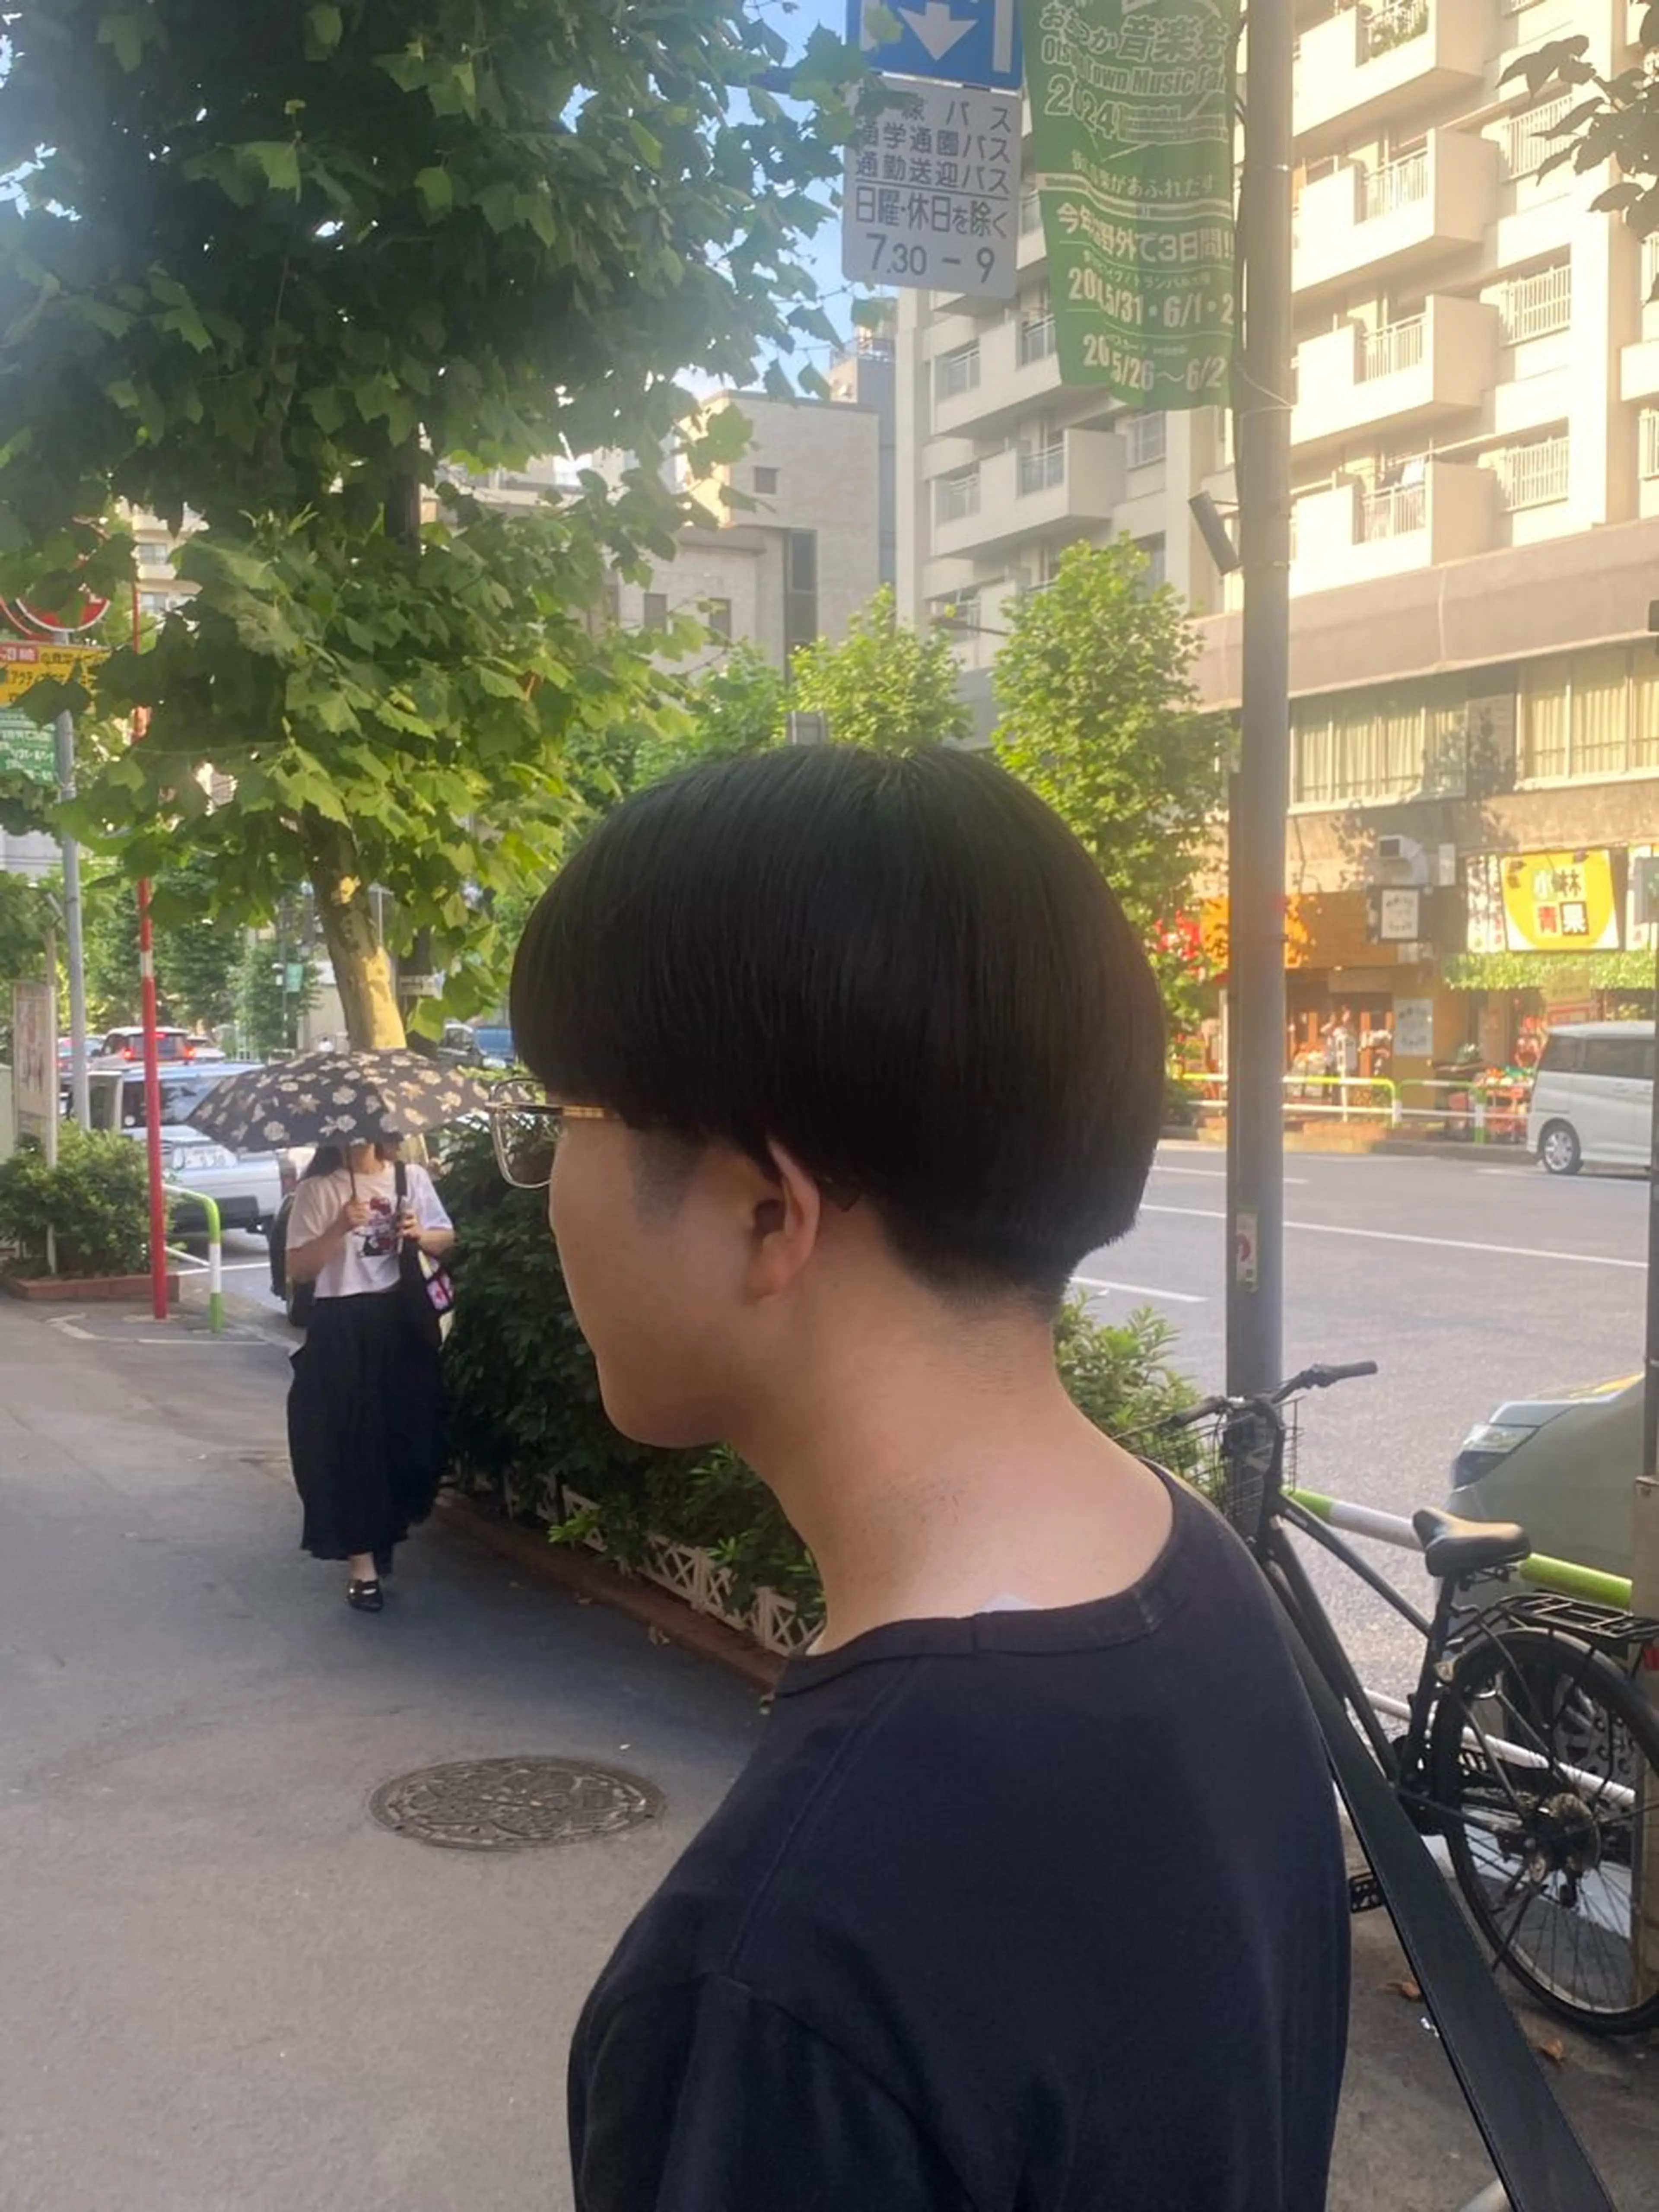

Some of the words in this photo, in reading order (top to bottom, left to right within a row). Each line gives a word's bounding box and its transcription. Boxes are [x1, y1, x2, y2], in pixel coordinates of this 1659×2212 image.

[1130, 67, 1197, 96] Music
[857, 122, 1011, 163] 通学通園バス
[856, 151, 1010, 194] 通勤送迎バス
[866, 232, 927, 276] 7.30
[976, 247, 995, 283] 9
